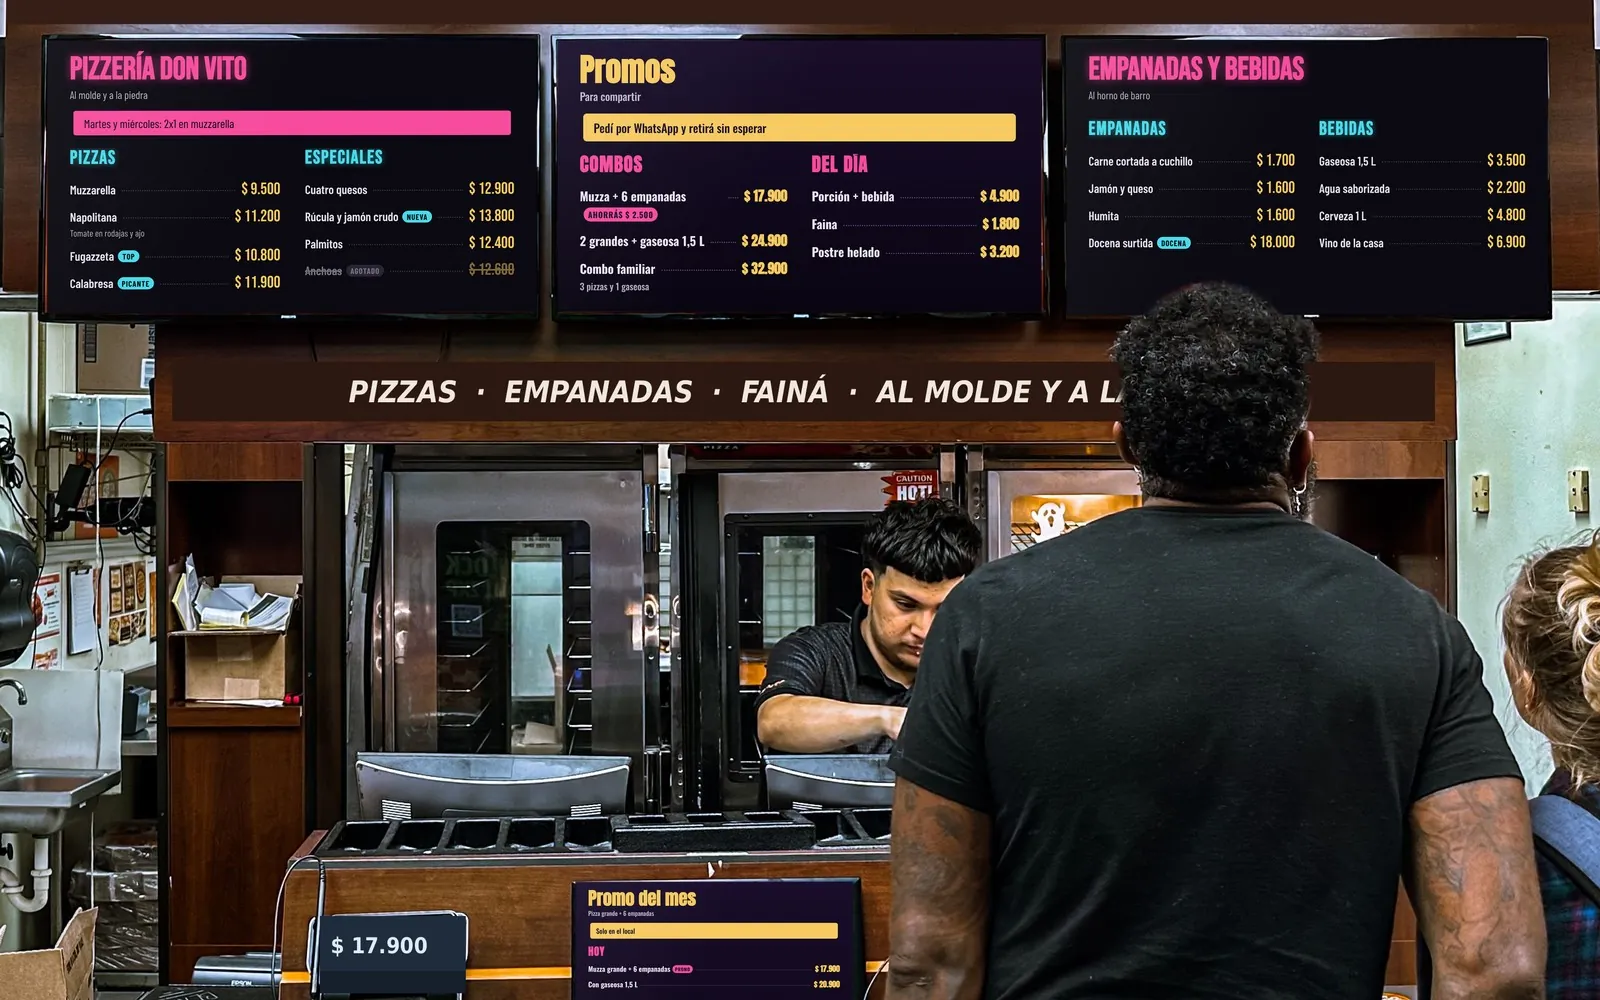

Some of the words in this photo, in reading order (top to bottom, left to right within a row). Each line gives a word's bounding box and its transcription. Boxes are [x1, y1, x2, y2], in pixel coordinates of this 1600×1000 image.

[70, 50, 156, 80] PIZZERÍA
[160, 55, 199, 81] DON
[204, 55, 247, 80] VITO
[580, 54, 676, 84] Promos
[1089, 55, 1203, 81] EMPANADAS
[1207, 56, 1221, 80] Y
[1225, 55, 1305, 81] BEBIDAS
[69, 91, 77, 100] Al
[78, 91, 101, 100] molde
[102, 93, 108, 102] y
[115, 91, 123, 100] la
[124, 91, 148, 101] piedra
[580, 92, 598, 102] Para
[600, 92, 641, 103] compartir
[1088, 91, 1095, 100] Al
[1096, 91, 1118, 100] horno
[1119, 91, 1129, 100] de
[1130, 91, 1151, 100] barro
[84, 119, 111, 129] Martes
[113, 122, 118, 131] y
[119, 119, 162, 129] miércoles:
[164, 119, 177, 129] 2x1
[178, 121, 189, 129] en
[190, 119, 235, 129] muzzarella
[594, 123, 614, 134] Pedí
[616, 125, 631, 136] por
[634, 123, 679, 136] WhatsApp
[681, 126, 686, 136] y
[689, 123, 714, 134] retirá
[716, 123, 730, 134] sin
[732, 125, 767, 136] esperar
[1088, 120, 1166, 136] EMPANADAS
[1319, 120, 1374, 136] BEBIDAS
[70, 149, 116, 165] PIZZAS
[305, 149, 383, 165] ESPECIALES
[580, 155, 643, 173] COMBOS
[812, 155, 838, 173] DEL
[1088, 156, 1114, 166] Carne
[1116, 156, 1149, 166] cortada
[1159, 156, 1193, 166] cuchillo
[1267, 153, 1295, 166] 1.700
[1319, 156, 1355, 166] Gaseosa
[1357, 156, 1369, 167] 1,5
[1371, 156, 1376, 166] L
[1496, 153, 1526, 166] 3.500
[70, 185, 116, 195] Muzzarella
[251, 182, 280, 195] 9.500
[305, 185, 334, 195] Cuatro
[336, 187, 368, 197] quesos
[479, 181, 514, 195] 12.900
[1088, 184, 1118, 194] Jamón
[1120, 186, 1125, 196] y
[1127, 186, 1154, 196] queso
[1267, 180, 1295, 194] 1.600
[1319, 184, 1341, 196] Agua
[1342, 183, 1390, 194] saborizada
[1496, 180, 1526, 194] 2.200
[580, 191, 610, 202] Muzza
[621, 191, 628, 202] 6
[631, 191, 686, 204] empanadas
[753, 189, 788, 202] 17.900
[812, 190, 850, 202] Porción
[861, 191, 894, 202] bebida
[989, 189, 1020, 202] 4.900
[70, 212, 117, 224] Napolitana
[245, 209, 280, 222] 11.200
[305, 212, 334, 222] Rúcula
[336, 214, 342, 224] y
[343, 212, 371, 224] jamón
[373, 212, 399, 222] crudo
[406, 214, 430, 222] NUEVA
[479, 209, 514, 222] 13.800
[588, 208, 623, 220] AHORRÁS
[632, 211, 653, 219] 2.500
[1088, 211, 1119, 221] Humita
[1267, 208, 1295, 221] 1.600
[1319, 211, 1353, 221] Cerveza
[1355, 211, 1359, 221] 1
[1361, 211, 1367, 221] L
[1496, 208, 1526, 221] 4.800
[812, 219, 837, 230] Faina
[991, 217, 1020, 230] 1.800
[70, 229, 94, 238] Tomate
[104, 229, 129, 239] rodajas
[134, 229, 145, 239] ajo
[305, 239, 343, 249] Palmitos
[479, 236, 514, 249] 12.400
[580, 235, 586, 247] 2
[589, 236, 629, 249] grandes
[640, 238, 679, 249] gaseosa
[682, 235, 696, 248] 1,5
[699, 236, 705, 247] L
[751, 234, 788, 247] 24.900
[1089, 238, 1120, 248] Docena
[1122, 238, 1153, 248] surtida
[1161, 240, 1186, 248] DOCENA
[1260, 235, 1295, 248] 18.000
[1319, 238, 1338, 248] Vino
[1340, 238, 1351, 248] de
[1353, 238, 1361, 248] la
[1363, 240, 1384, 248] casa
[1496, 235, 1526, 248] 6.900
[70, 252, 114, 264] Fugazzeta
[245, 248, 280, 261] 10.800
[812, 247, 844, 258] Postre
[847, 247, 880, 258] helado
[989, 245, 1020, 258] 3.200
[305, 266, 343, 276] Anchoas
[350, 267, 380, 275] AGOTADO
[479, 263, 514, 275] 12.600
[580, 263, 614, 275] Combo
[616, 263, 656, 275] familiar
[751, 261, 788, 275] 32.900
[70, 279, 113, 289] Calabresa
[121, 280, 149, 288] PICANTE
[245, 275, 280, 288] 11.900
[579, 282, 585, 291] 3
[586, 283, 608, 292] pizzas
[616, 282, 619, 291] 1
[621, 284, 650, 293] gaseosa
[349, 380, 456, 403] PIZZAS
[505, 380, 692, 403] EMPANADAS
[741, 374, 828, 403] FAINÁ
[875, 380, 913, 403] AL
[924, 380, 1032, 403] MOLDE
[1042, 380, 1062, 403] Y
[1068, 380, 1088, 403] A
[1100, 380, 1124, 403] L
[588, 889, 635, 906] Promo
[638, 889, 661, 906] del
[665, 891, 696, 907] mes
[353, 936, 427, 954] 17.900
[588, 946, 605, 956] HOY
[607, 966, 627, 974] grande
[638, 966, 671, 974] empanadas
[820, 965, 840, 973] 17.900
[819, 980, 840, 988] 20.900
